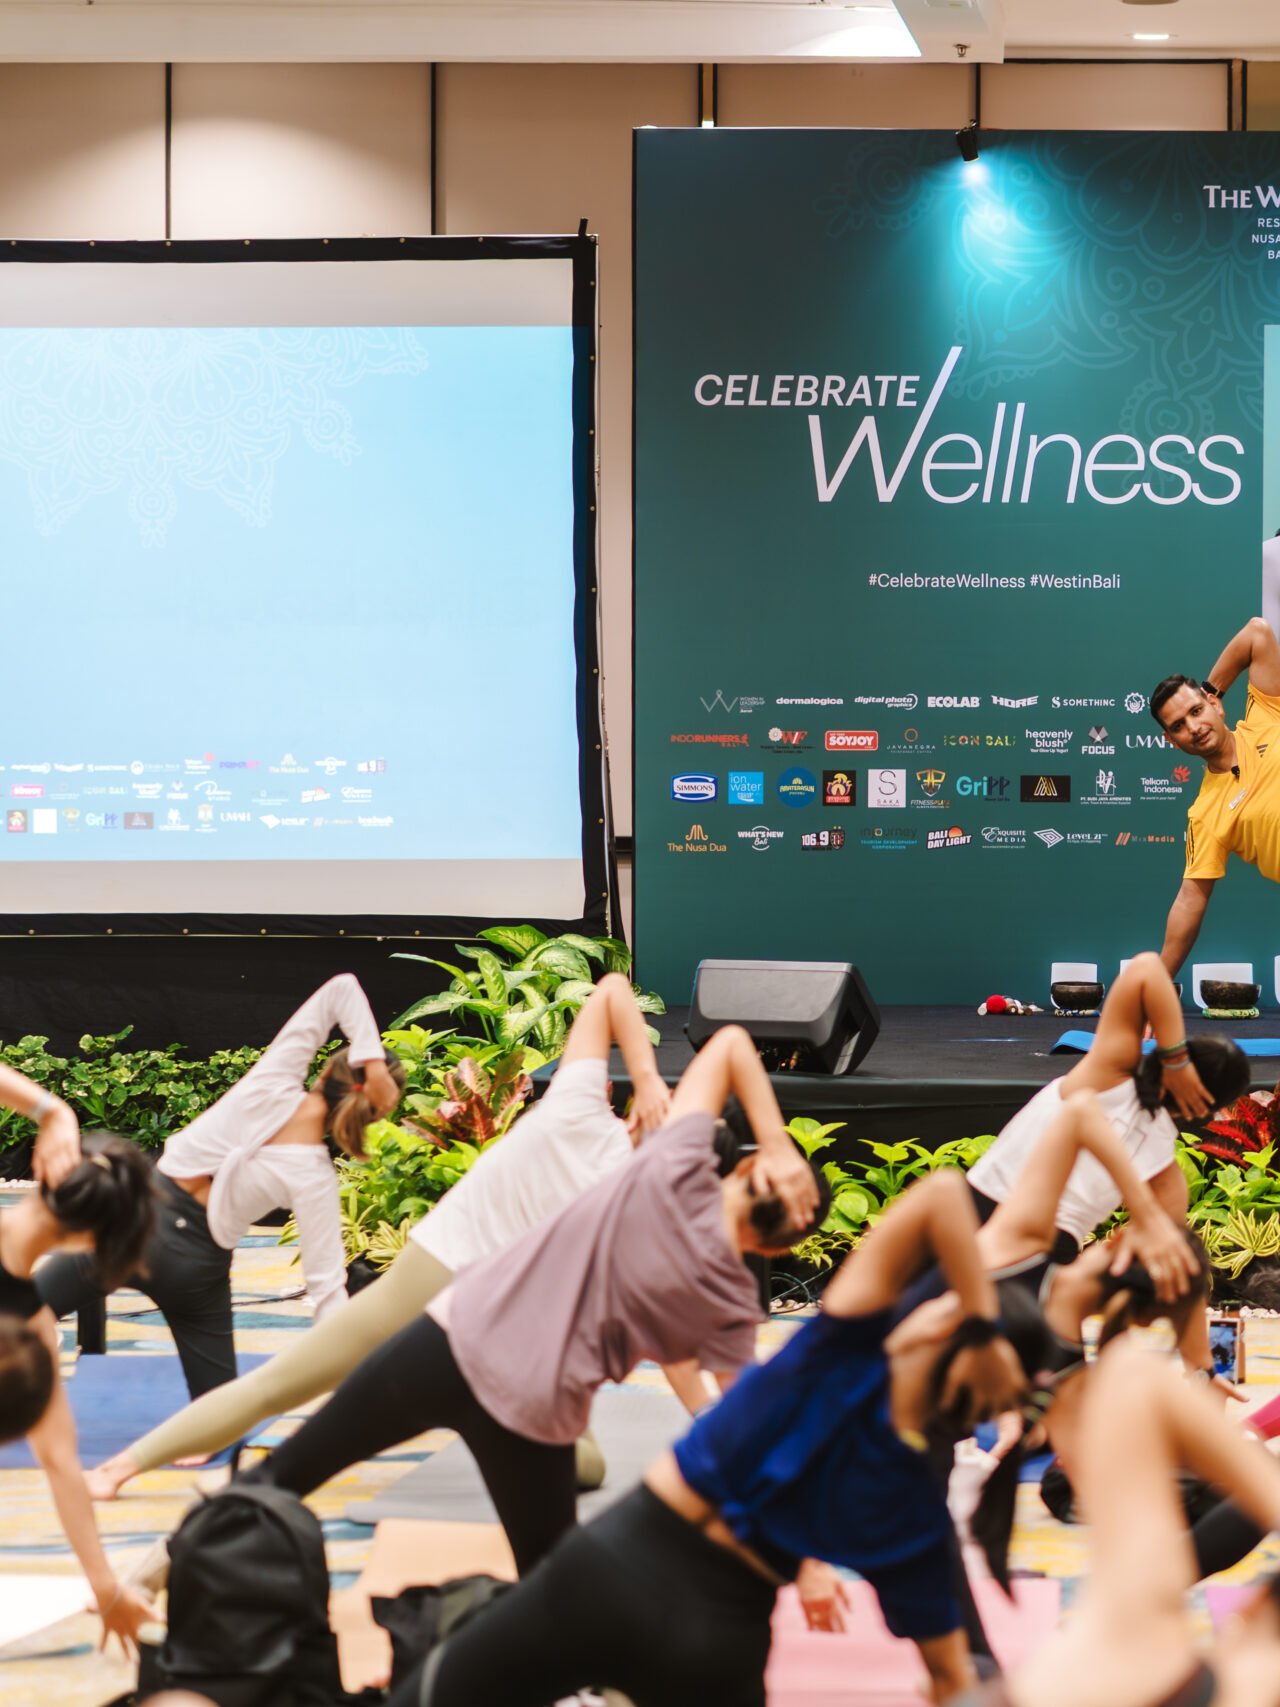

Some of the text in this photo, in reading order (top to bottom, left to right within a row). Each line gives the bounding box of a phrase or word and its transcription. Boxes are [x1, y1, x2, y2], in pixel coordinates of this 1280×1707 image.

[1203, 185, 1253, 209] THE
[694, 374, 920, 407] CELEBRATE
[808, 346, 1245, 506] Wellness
[868, 572, 1121, 590] #CelebrateWellness #WestinBali
[776, 697, 844, 706] dermalogica
[854, 696, 913, 705] digital photo
[927, 696, 980, 708] ECOLAB
[1063, 698, 1116, 707] SOMETHINC
[670, 734, 740, 743] INDORUNNERS
[1025, 729, 1073, 740] heavenly
[829, 735, 874, 746] SOYJOY
[943, 735, 1016, 746] ICON BALI
[1081, 745, 1115, 755] FOCUS
[730, 774, 747, 784] ion
[1140, 777, 1169, 786] Telkom
[730, 783, 762, 792] water
[1144, 785, 1183, 793] Indonesia
[801, 830, 829, 846] 106.9
[928, 829, 948, 840] BALI
[981, 827, 1026, 842] EXQUISITE
[754, 837, 768, 846] Bali
[927, 835, 972, 849] DAY LIGHT
[667, 843, 727, 852] The Nusa Dua
